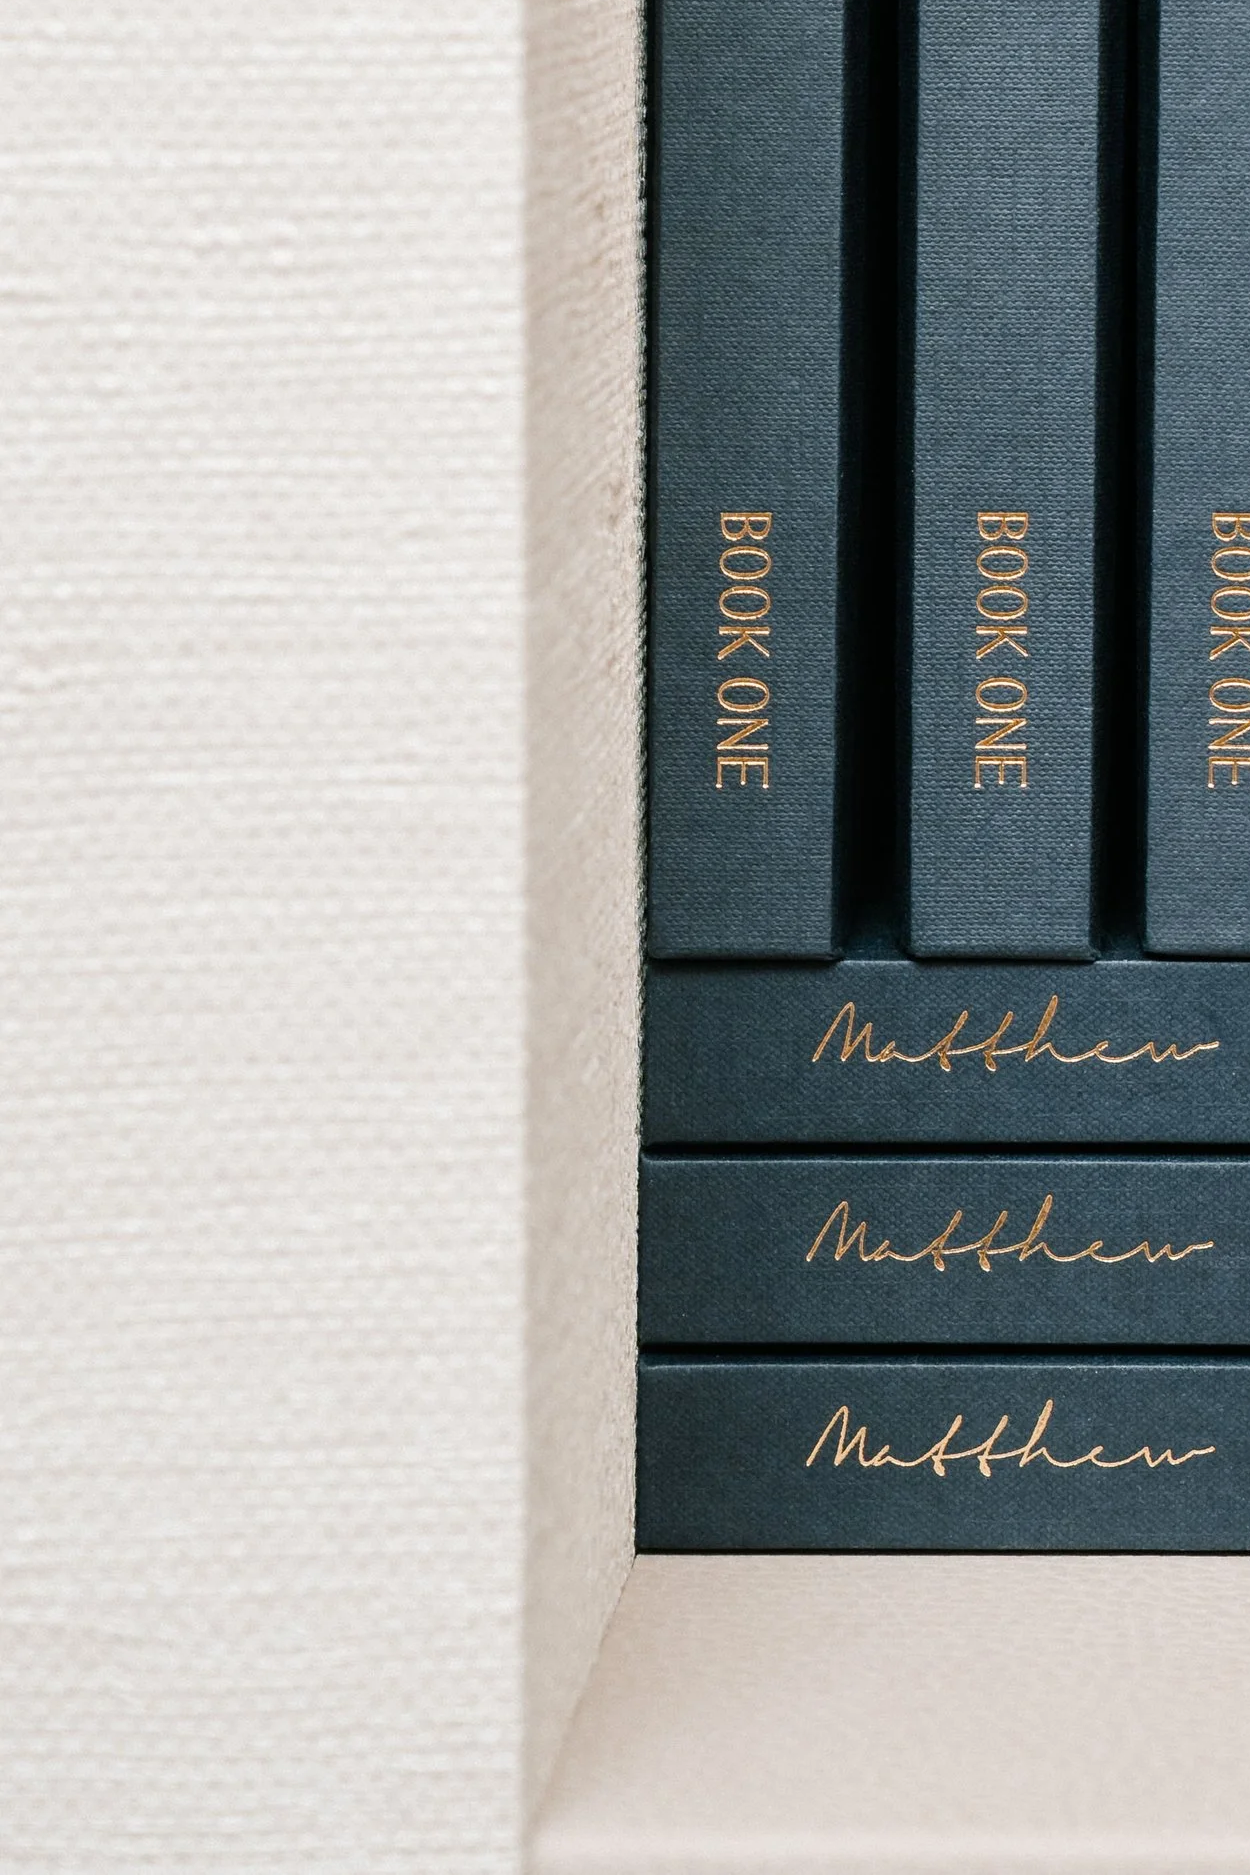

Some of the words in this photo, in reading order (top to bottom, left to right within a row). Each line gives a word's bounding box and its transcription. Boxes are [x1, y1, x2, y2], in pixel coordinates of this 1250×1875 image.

[718, 512, 772, 659] BOOK
[976, 512, 1029, 658] BOOK
[717, 677, 769, 788] ONE
[975, 677, 1028, 786] ONE
[813, 996, 1218, 1070] Matthew
[806, 1194, 1214, 1270] Matthew
[807, 1399, 1215, 1476] Matthew
